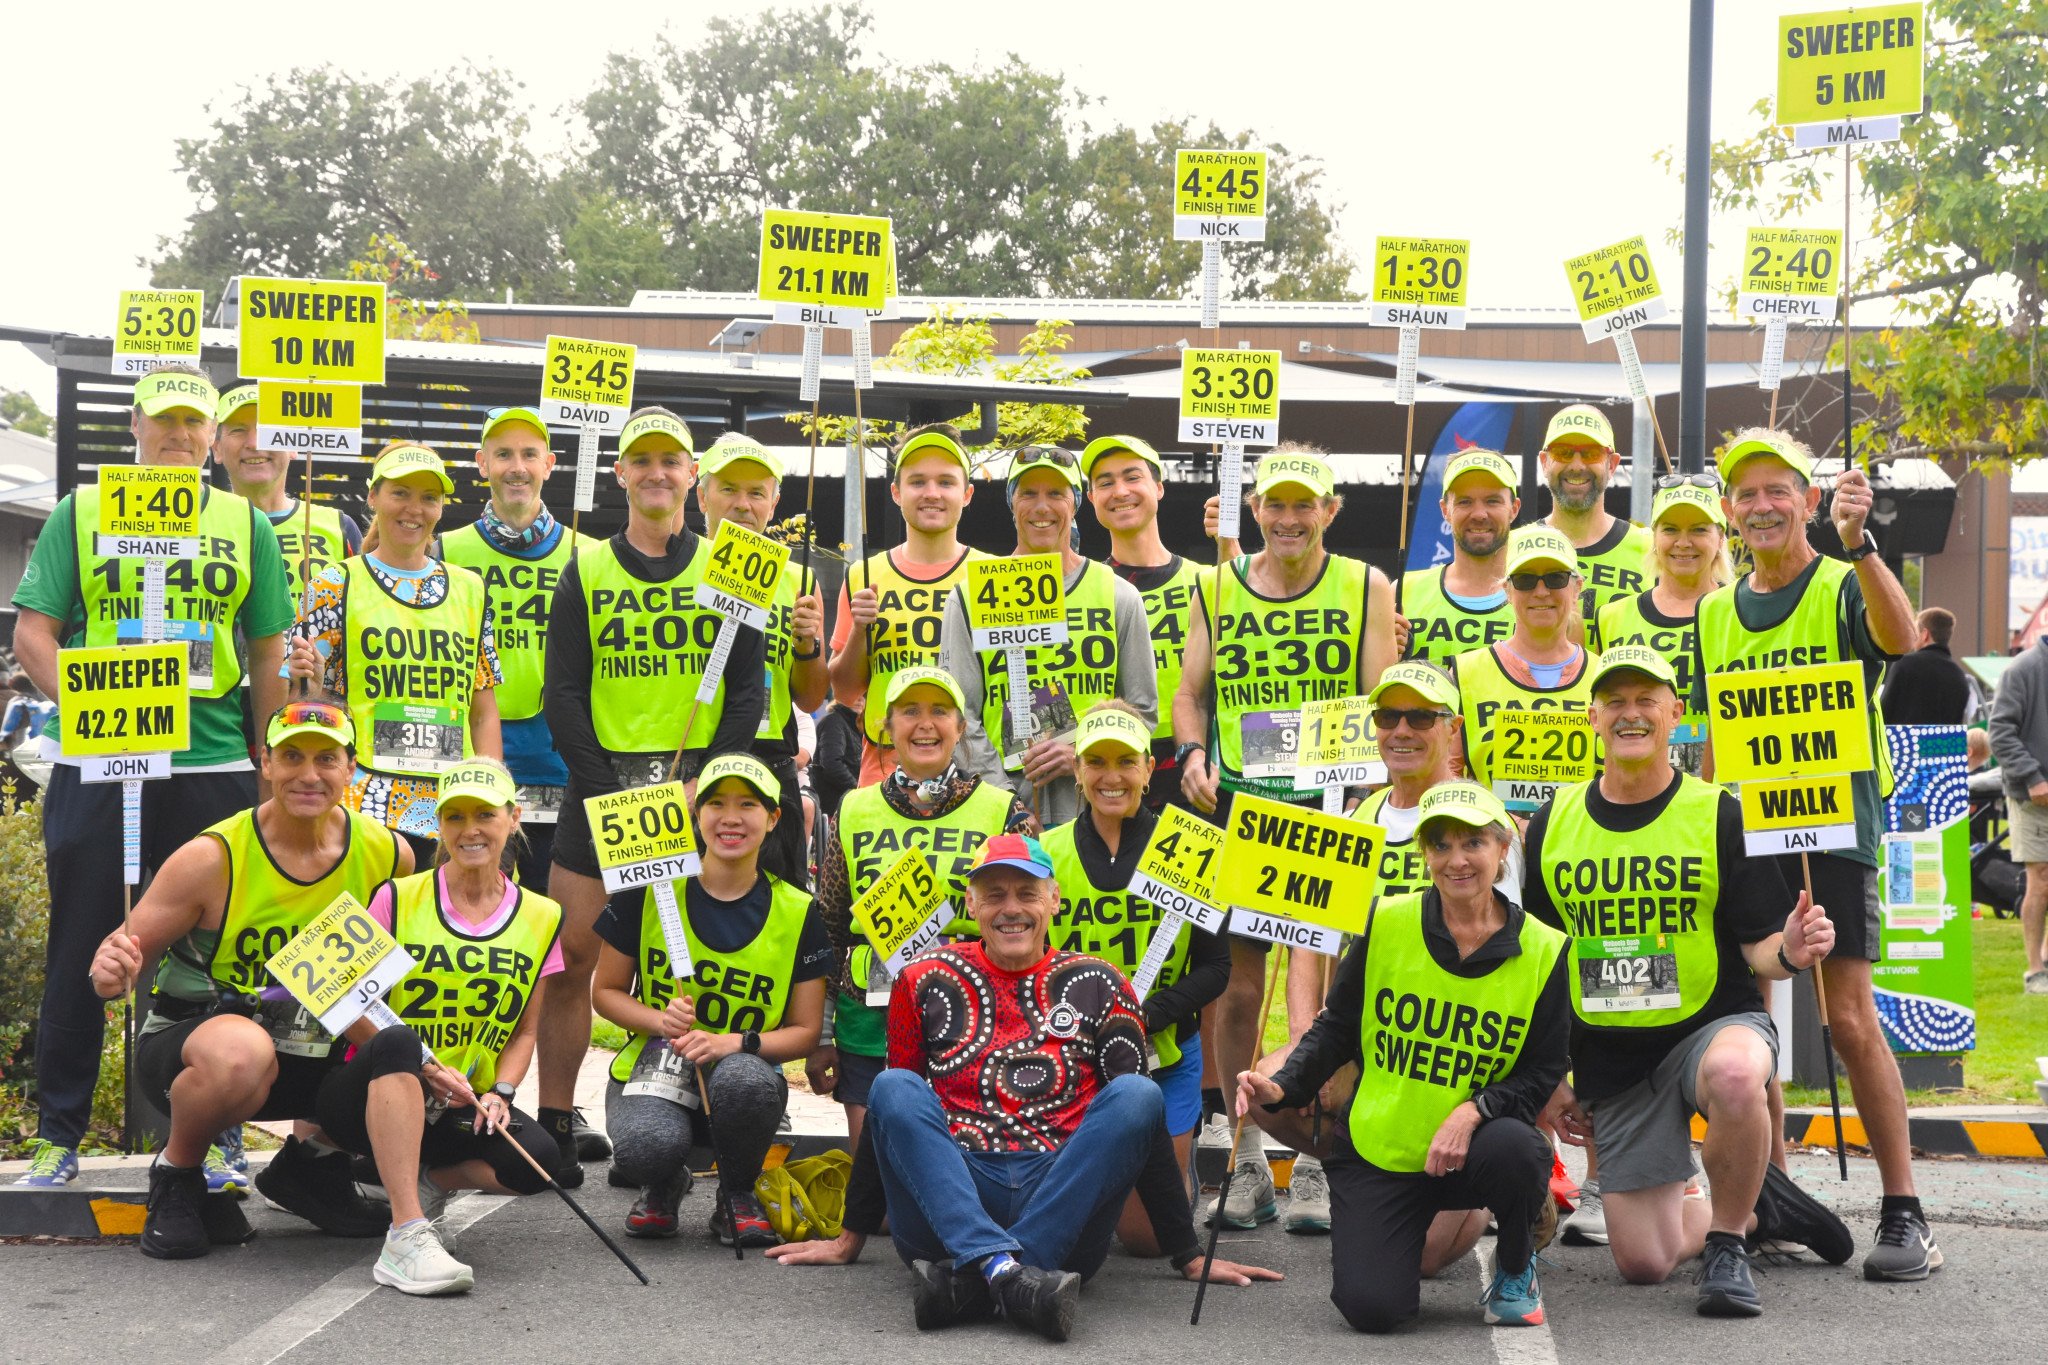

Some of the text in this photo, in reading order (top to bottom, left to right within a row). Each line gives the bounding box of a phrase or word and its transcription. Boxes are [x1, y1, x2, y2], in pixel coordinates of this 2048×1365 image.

[1787, 16, 1914, 58] SWEEPER
[1816, 69, 1886, 106] 5 KM
[1827, 124, 1869, 143] MAL
[1187, 154, 1256, 165] MARATHON
[1181, 167, 1259, 200] 4:45
[1183, 201, 1256, 213] FINISH TIME
[769, 223, 882, 257] SWEEPER
[1200, 222, 1240, 236] NICK
[1751, 233, 1837, 245] HALF MARATHON
[1380, 240, 1467, 254] HALF MARATHON
[1569, 238, 1645, 271] HALF MARATHON
[1382, 255, 1462, 289] 1:30
[1749, 246, 1832, 280] 2:40
[777, 265, 869, 297] 21.1 KM
[1577, 252, 1651, 302] 2:10
[1749, 280, 1828, 293] FINISH TIME
[129, 293, 195, 304] MARATHON
[249, 290, 376, 324] SWEEPER
[1381, 289, 1459, 303] FINISH TIME
[1587, 283, 1655, 314] FINISH TIME
[1752, 298, 1821, 315] CHERYL
[123, 306, 196, 338] 5:30
[800, 308, 838, 325] BILL
[1387, 309, 1448, 325] SHAUN
[1604, 307, 1648, 334] JOHN
[123, 340, 193, 352] FINISH TIME
[271, 336, 355, 367] 10 KM
[557, 341, 626, 358] MARATHON
[1196, 352, 1271, 364] MARATHON
[551, 354, 627, 391] 3:45
[1191, 366, 1274, 400] 3:30
[156, 380, 208, 400] PACER
[551, 386, 624, 404] FINISH TIME
[281, 391, 333, 418] RUN
[559, 405, 610, 424] DAVID
[1192, 402, 1271, 415] FINISH TIME
[632, 418, 680, 436] PACER
[1192, 422, 1265, 440] STEVEN
[1556, 415, 1601, 431] PACER
[270, 431, 350, 449] ANDREA
[722, 445, 769, 463] SWEEPER
[1453, 455, 1501, 472] PACER
[107, 473, 196, 484] HALF MARATHON
[1269, 460, 1320, 479] PACER
[110, 486, 194, 519] 1:40
[1665, 490, 1713, 506] PACER
[111, 520, 193, 533] FINISH TIME
[117, 540, 180, 556] SHANE
[726, 526, 783, 558] MARATHON
[1517, 536, 1566, 553] PACER
[713, 541, 778, 588] 4:00
[979, 560, 1053, 576] MARATHON
[708, 570, 768, 604] FINISH TIME
[977, 573, 1058, 609] 4:30
[183, 597, 229, 625] TIME
[712, 593, 752, 622] MATT
[981, 611, 1024, 625] FINISH
[1027, 608, 1059, 621] TIME
[597, 615, 726, 652] 4:00
[988, 627, 1052, 646] BRUCE
[1213, 608, 1351, 642] PACER
[360, 626, 475, 671] COURSE
[1216, 638, 1352, 681] 3:30
[1602, 650, 1656, 669] SWEEPER
[66, 656, 180, 693] SWEEPER
[601, 654, 667, 680] FINISH
[901, 669, 951, 685] PACER
[1385, 664, 1436, 688] PACER
[363, 664, 472, 707] SWEEPER
[1063, 672, 1115, 695] TIME
[1220, 679, 1349, 710] FINISH TIME
[1307, 703, 1331, 715] HALF
[1718, 680, 1856, 721] SWEEPER
[75, 705, 174, 740] 42.2 KM
[1086, 715, 1136, 733] PACER
[1309, 713, 1377, 747] 1:50
[1502, 714, 1591, 726] HALF MARATHON
[401, 723, 438, 748] 315
[1503, 728, 1588, 762] 2:20
[1746, 730, 1838, 766] 10 KM
[404, 747, 435, 757] ANDREA
[1306, 745, 1380, 762] FINISH TIME
[102, 758, 149, 777] JOHN
[443, 770, 496, 789] PACER
[649, 761, 663, 782] 3
[711, 761, 764, 781] PACER
[1314, 766, 1368, 785] DAVID
[1504, 763, 1585, 776] FINISH TIME
[598, 787, 676, 811] MARATHON
[1422, 790, 1477, 814] SWEEPER
[1759, 785, 1840, 819] WALK
[601, 801, 685, 846] 5:00
[608, 836, 689, 862] FINISH TIME
[852, 826, 990, 859] PACER
[1237, 809, 1373, 869] SWEEPER
[1784, 831, 1818, 849] IAN
[618, 859, 686, 884] KRISTY
[863, 854, 917, 911] MARATHON
[1148, 861, 1191, 889] FINISH
[1554, 855, 1703, 899] COURSE
[1257, 866, 1334, 911] 2 KM
[869, 864, 934, 940] 5:15
[1142, 880, 1210, 925] NICOLE
[886, 894, 941, 952] FINISH TIME
[1564, 897, 1699, 938] SWEEPER
[276, 942, 303, 970] HALF
[301, 898, 355, 949] MARATHON
[901, 915, 943, 962] SALLY
[1247, 917, 1325, 949] JANICE
[291, 913, 375, 996] 2:30
[404, 944, 534, 985] PACER
[316, 937, 388, 1006] FINISH TIME
[1601, 957, 1651, 984] 402
[1873, 965, 1920, 976] NETWORK
[359, 979, 381, 1004] JO
[400, 978, 523, 1024] 2:30
[1618, 985, 1634, 995] IAN
[1374, 987, 1527, 1055] COURSE
[658, 1048, 684, 1075] 14
[1374, 1030, 1507, 1091] SWEEPER
[651, 1071, 682, 1086] KRISTY
